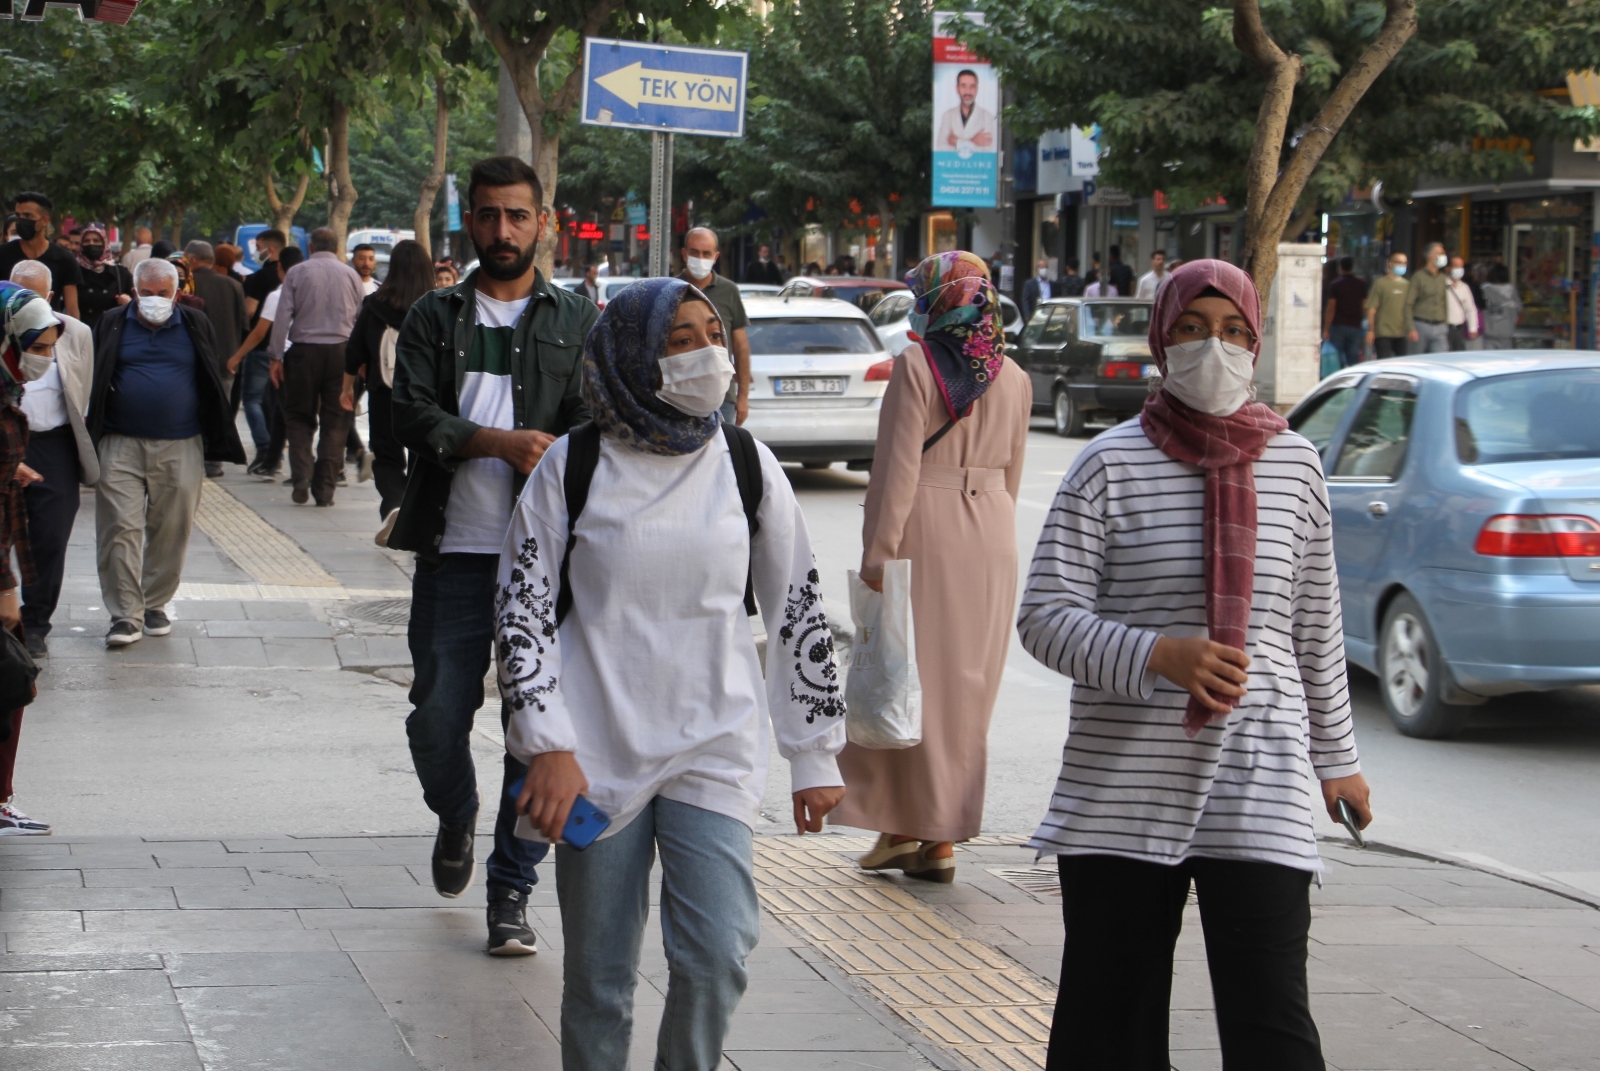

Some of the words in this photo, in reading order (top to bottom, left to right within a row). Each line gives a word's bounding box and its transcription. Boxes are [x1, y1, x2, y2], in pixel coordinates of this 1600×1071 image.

[640, 77, 678, 99] TEK
[685, 78, 732, 104] YÖN
[782, 380, 796, 391] 23
[801, 380, 816, 391] BN
[821, 380, 841, 391] 731
